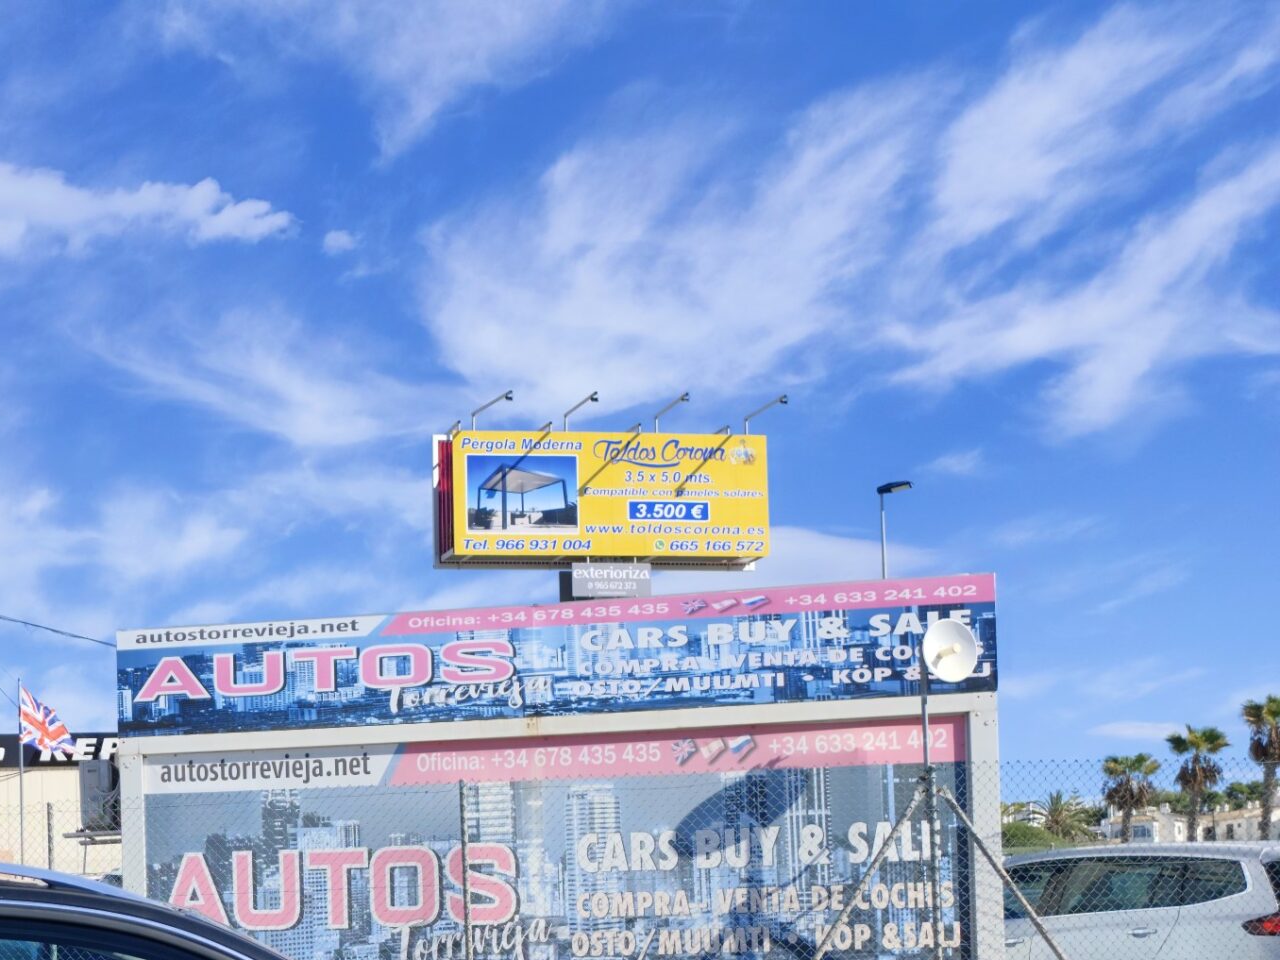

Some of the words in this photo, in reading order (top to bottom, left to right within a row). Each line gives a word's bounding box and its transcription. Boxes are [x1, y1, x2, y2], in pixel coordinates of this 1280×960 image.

[521, 438, 582, 450] Moderna
[593, 439, 657, 464] Toldos
[661, 439, 727, 462] Corona
[648, 474, 656, 482] x
[584, 487, 648, 498] Compatible
[652, 489, 673, 497] con
[675, 489, 720, 498] paneles
[723, 489, 763, 498] solares
[635, 503, 686, 518] 3.500
[690, 504, 704, 518] €
[585, 523, 765, 535] www.toldoscorona.es
[464, 539, 489, 550] Tel.
[495, 539, 525, 550] 966
[529, 539, 557, 550] 931
[562, 539, 592, 550] 004
[669, 540, 699, 551] 665
[704, 540, 731, 551] 166
[735, 540, 764, 551] 572
[573, 566, 650, 579] exterioriza
[408, 614, 481, 630] Oficina:
[487, 611, 527, 624] +34
[533, 608, 575, 621] 678
[580, 605, 621, 618] 435
[627, 602, 670, 616] 435
[784, 593, 827, 606] +34
[833, 591, 877, 604] 633
[883, 588, 927, 601] 241
[933, 584, 978, 597] 402
[135, 619, 359, 645] autostorrevieja.net
[579, 625, 689, 651] CARS
[707, 619, 798, 646] BUY
[819, 616, 850, 639] &
[728, 649, 818, 671] VENTA
[827, 646, 864, 664] DE
[133, 639, 518, 704] AUTOS
[832, 664, 893, 685] KÖP
[381, 675, 554, 714] Torrevieja
[416, 751, 485, 772] Oficina:
[490, 749, 528, 769] +34
[534, 746, 572, 767] 678
[577, 744, 617, 765] 435
[622, 742, 661, 763] 435
[768, 735, 808, 756] +34
[814, 732, 856, 754] 633
[861, 730, 901, 751] 241
[159, 755, 372, 784] autostorrevieja.net
[577, 830, 680, 873] CARS
[695, 826, 781, 869] BUY
[798, 823, 830, 865] &
[167, 842, 518, 931] AUTOS
[716, 885, 801, 915] VENTA
[811, 884, 845, 912] DE
